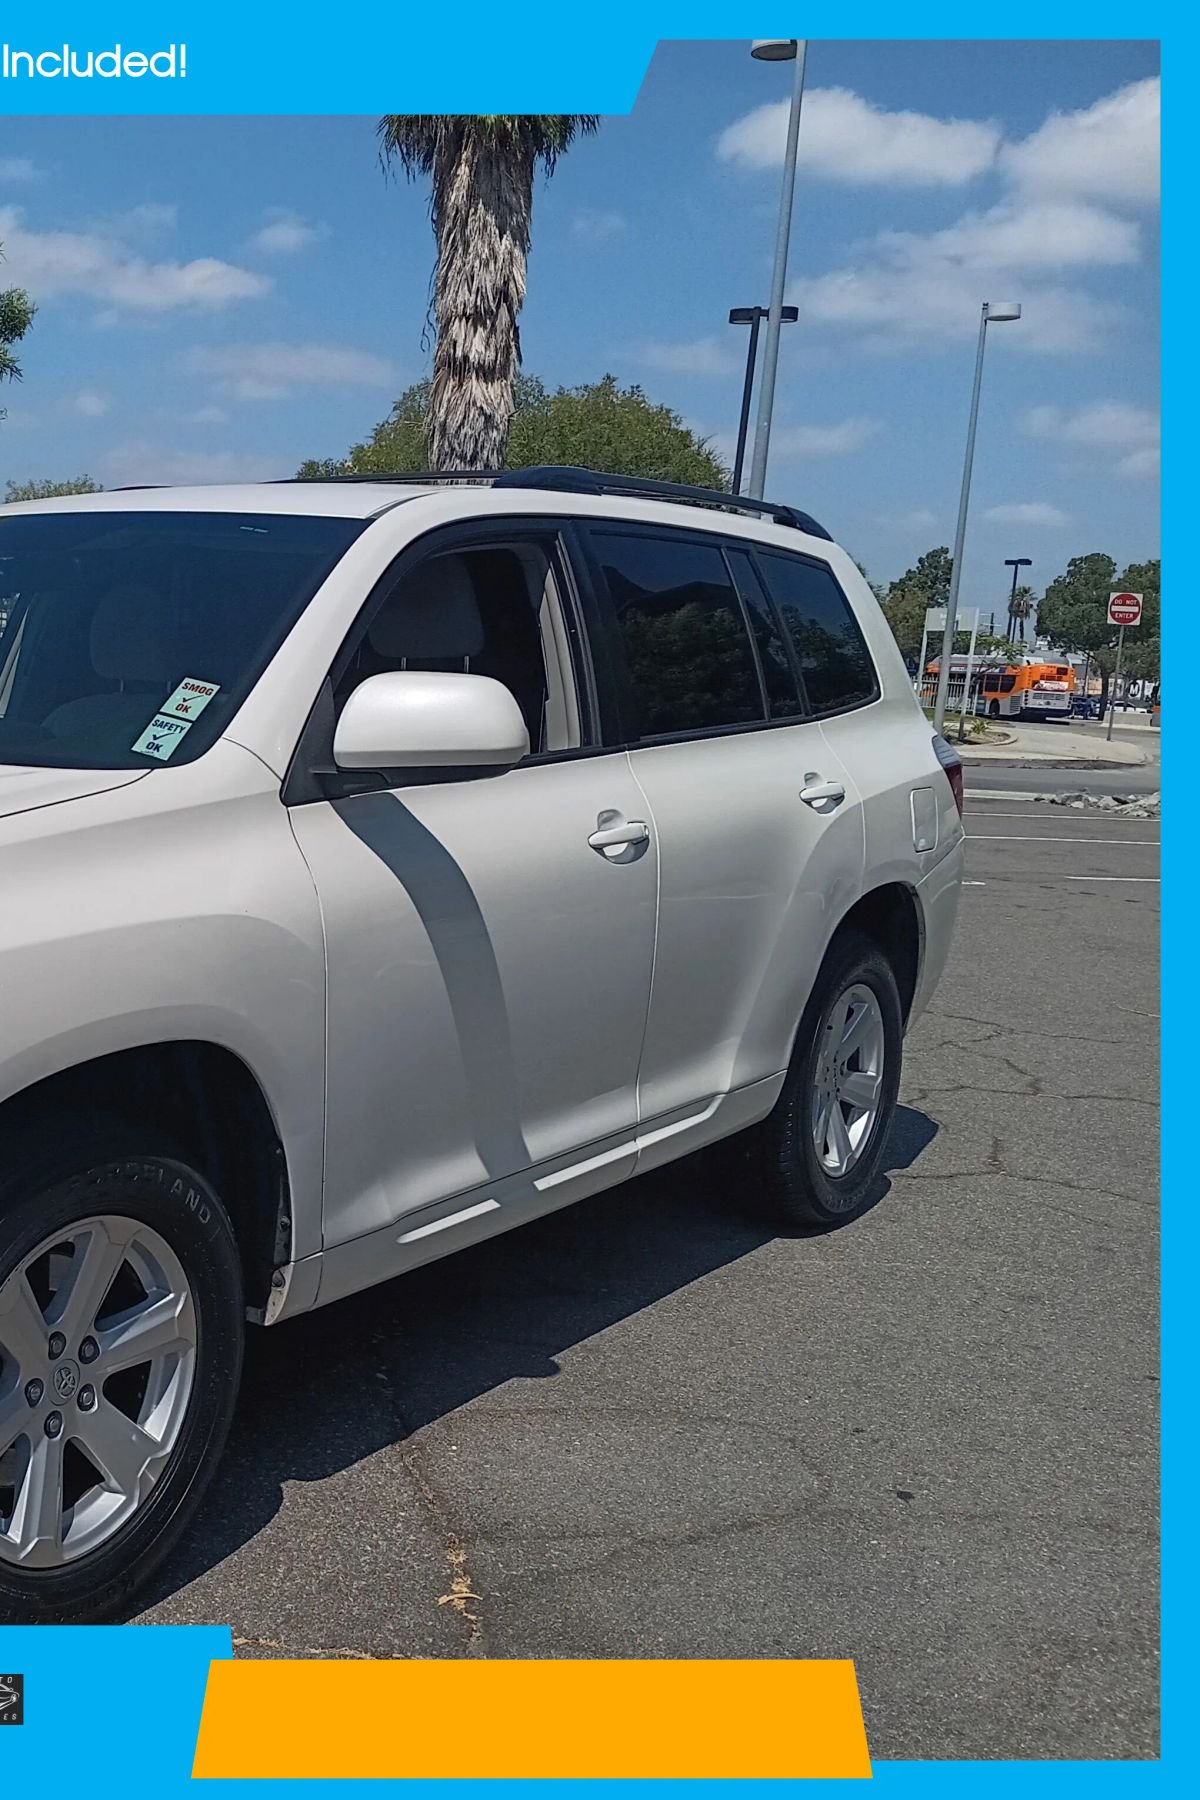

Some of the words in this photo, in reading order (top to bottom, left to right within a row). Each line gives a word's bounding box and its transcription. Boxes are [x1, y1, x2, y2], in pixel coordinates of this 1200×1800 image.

[181, 682, 215, 696] SMOG
[175, 703, 192, 714] OK
[151, 719, 187, 734] SAFETY
[145, 741, 164, 753] OK
